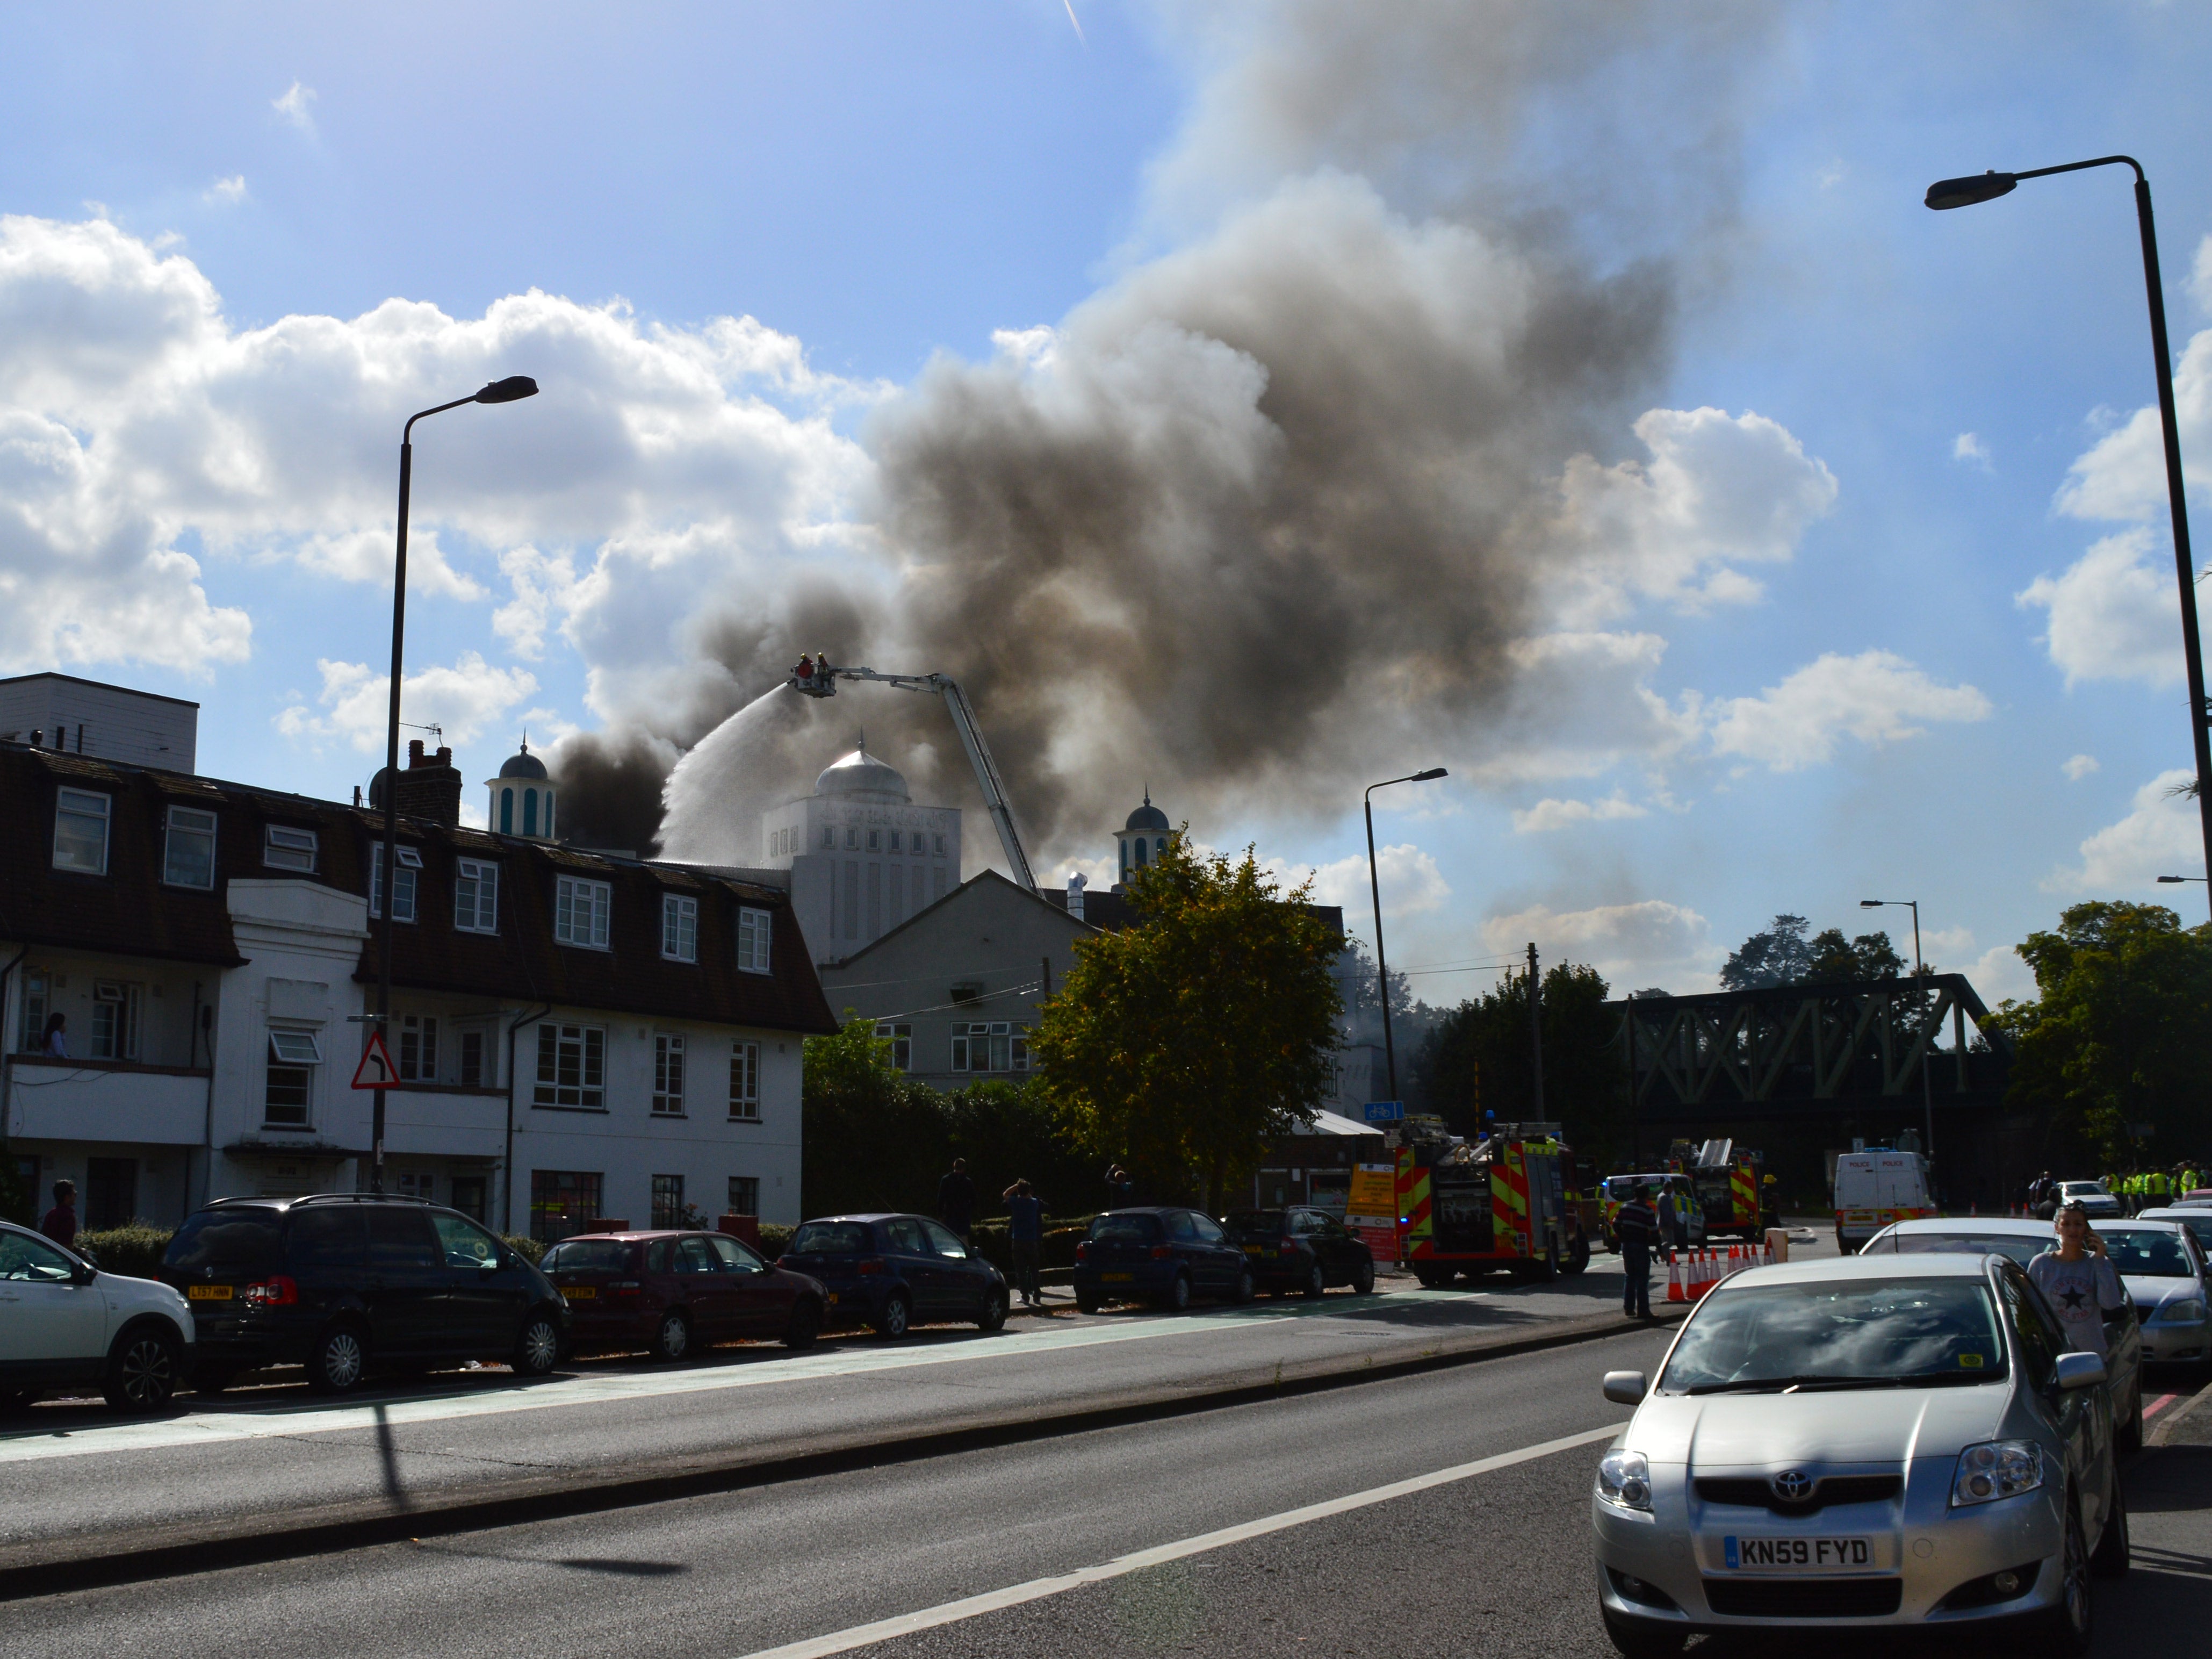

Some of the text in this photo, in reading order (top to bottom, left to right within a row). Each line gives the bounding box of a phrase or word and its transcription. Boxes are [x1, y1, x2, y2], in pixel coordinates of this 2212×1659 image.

[192, 1287, 211, 1297] LT57
[2059, 1308, 2089, 1319] ALL STAR
[1741, 1540, 1867, 1564] KN59 FYD
